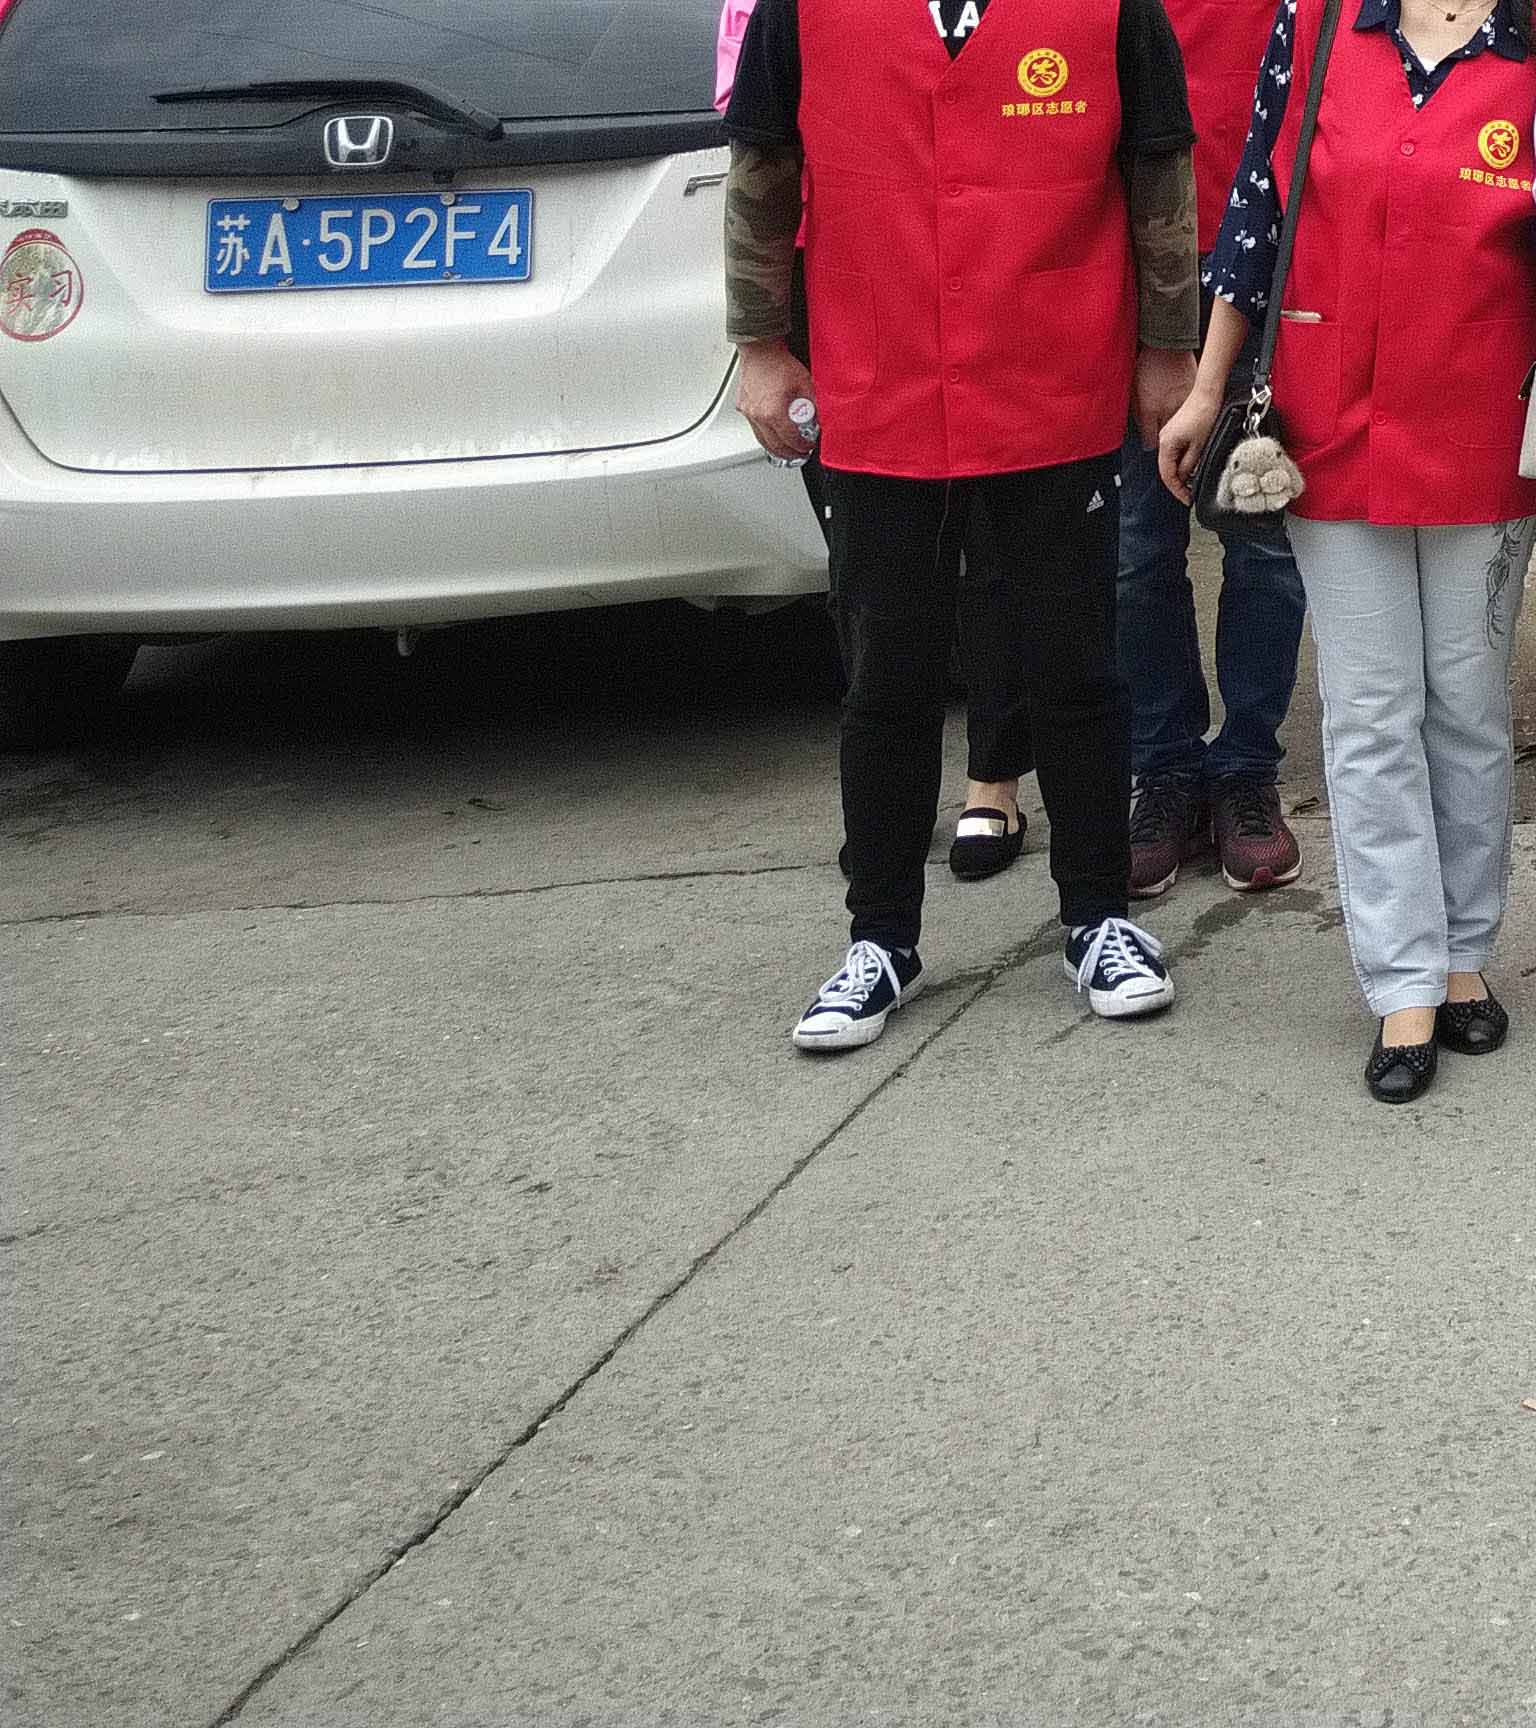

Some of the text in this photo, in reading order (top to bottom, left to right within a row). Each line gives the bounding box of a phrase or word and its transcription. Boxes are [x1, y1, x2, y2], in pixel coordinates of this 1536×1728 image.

[1002, 100, 1088, 117] 琅琊区志愿者
[6, 270, 73, 315] 实习
